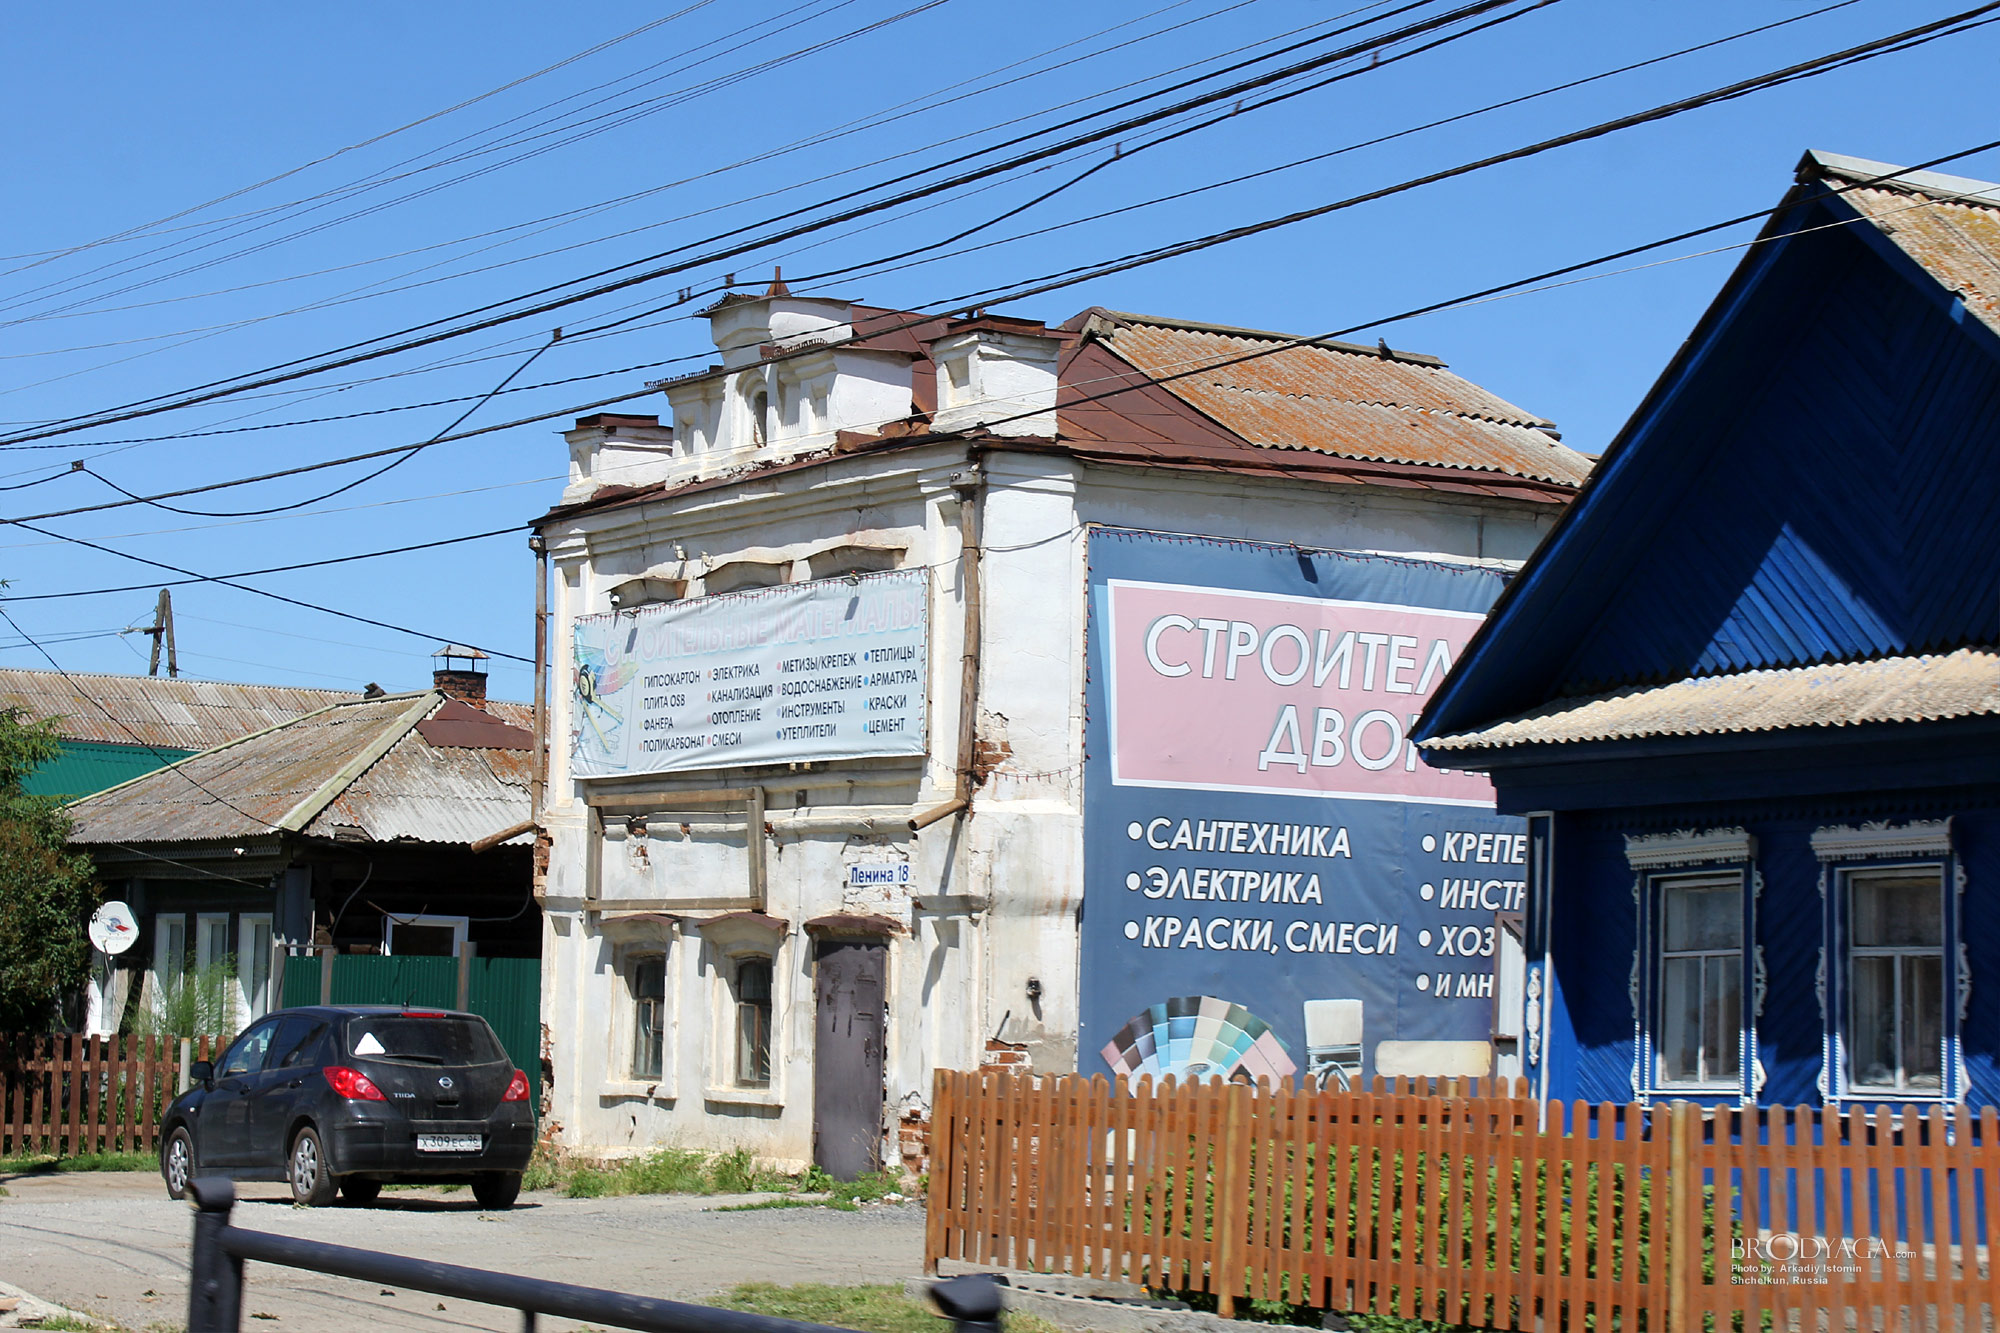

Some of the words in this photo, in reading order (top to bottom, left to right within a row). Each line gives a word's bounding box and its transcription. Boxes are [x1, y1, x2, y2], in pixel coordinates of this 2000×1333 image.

[604, 614, 768, 665] СТРОИТЕЛЬНЫЕ
[774, 590, 921, 643] МАТЕРИАЛЫ
[781, 652, 857, 674] МЕТИЗЫ/КРЕПЕЖ
[870, 645, 915, 663] ТЕПЛИЦЫ
[643, 670, 701, 688] ГИПСОКАРТОН
[712, 663, 760, 681] ЭЛЕКТРИКА
[869, 669, 918, 687] АРМАТУРА
[711, 684, 773, 703] КАНАЛИЗАЦИЯ
[781, 674, 862, 697] ВОДОСНАБЖЕНИЕ
[643, 696, 669, 710] ПЛИТА
[781, 700, 845, 719] ИНСТРУМЕНТЫ
[868, 694, 907, 711] КРАСКИ
[643, 717, 674, 731] ФАНЕРА
[711, 708, 761, 725] ОТОПЛЕНИЕ
[781, 723, 837, 741] УТЕПЛИТЕЛИ
[868, 717, 905, 736] ЦЕМЕНТ
[643, 735, 705, 752] ПОЛИКАРБОНАТ
[712, 732, 742, 747] СМЕСИ
[1146, 816, 1352, 858] САНТЕХНИКА
[1441, 831, 1527, 864] КРЕПЕ
[851, 867, 893, 883] Ленина
[897, 865, 909, 882] 18
[1143, 866, 1323, 905] ЭЛЕКТРИКА
[1142, 915, 1279, 955] КРАСКИ,
[1284, 921, 1399, 955] СМЕСИ
[1436, 925, 1495, 957] ХОЗ
[1434, 973, 1451, 998] И
